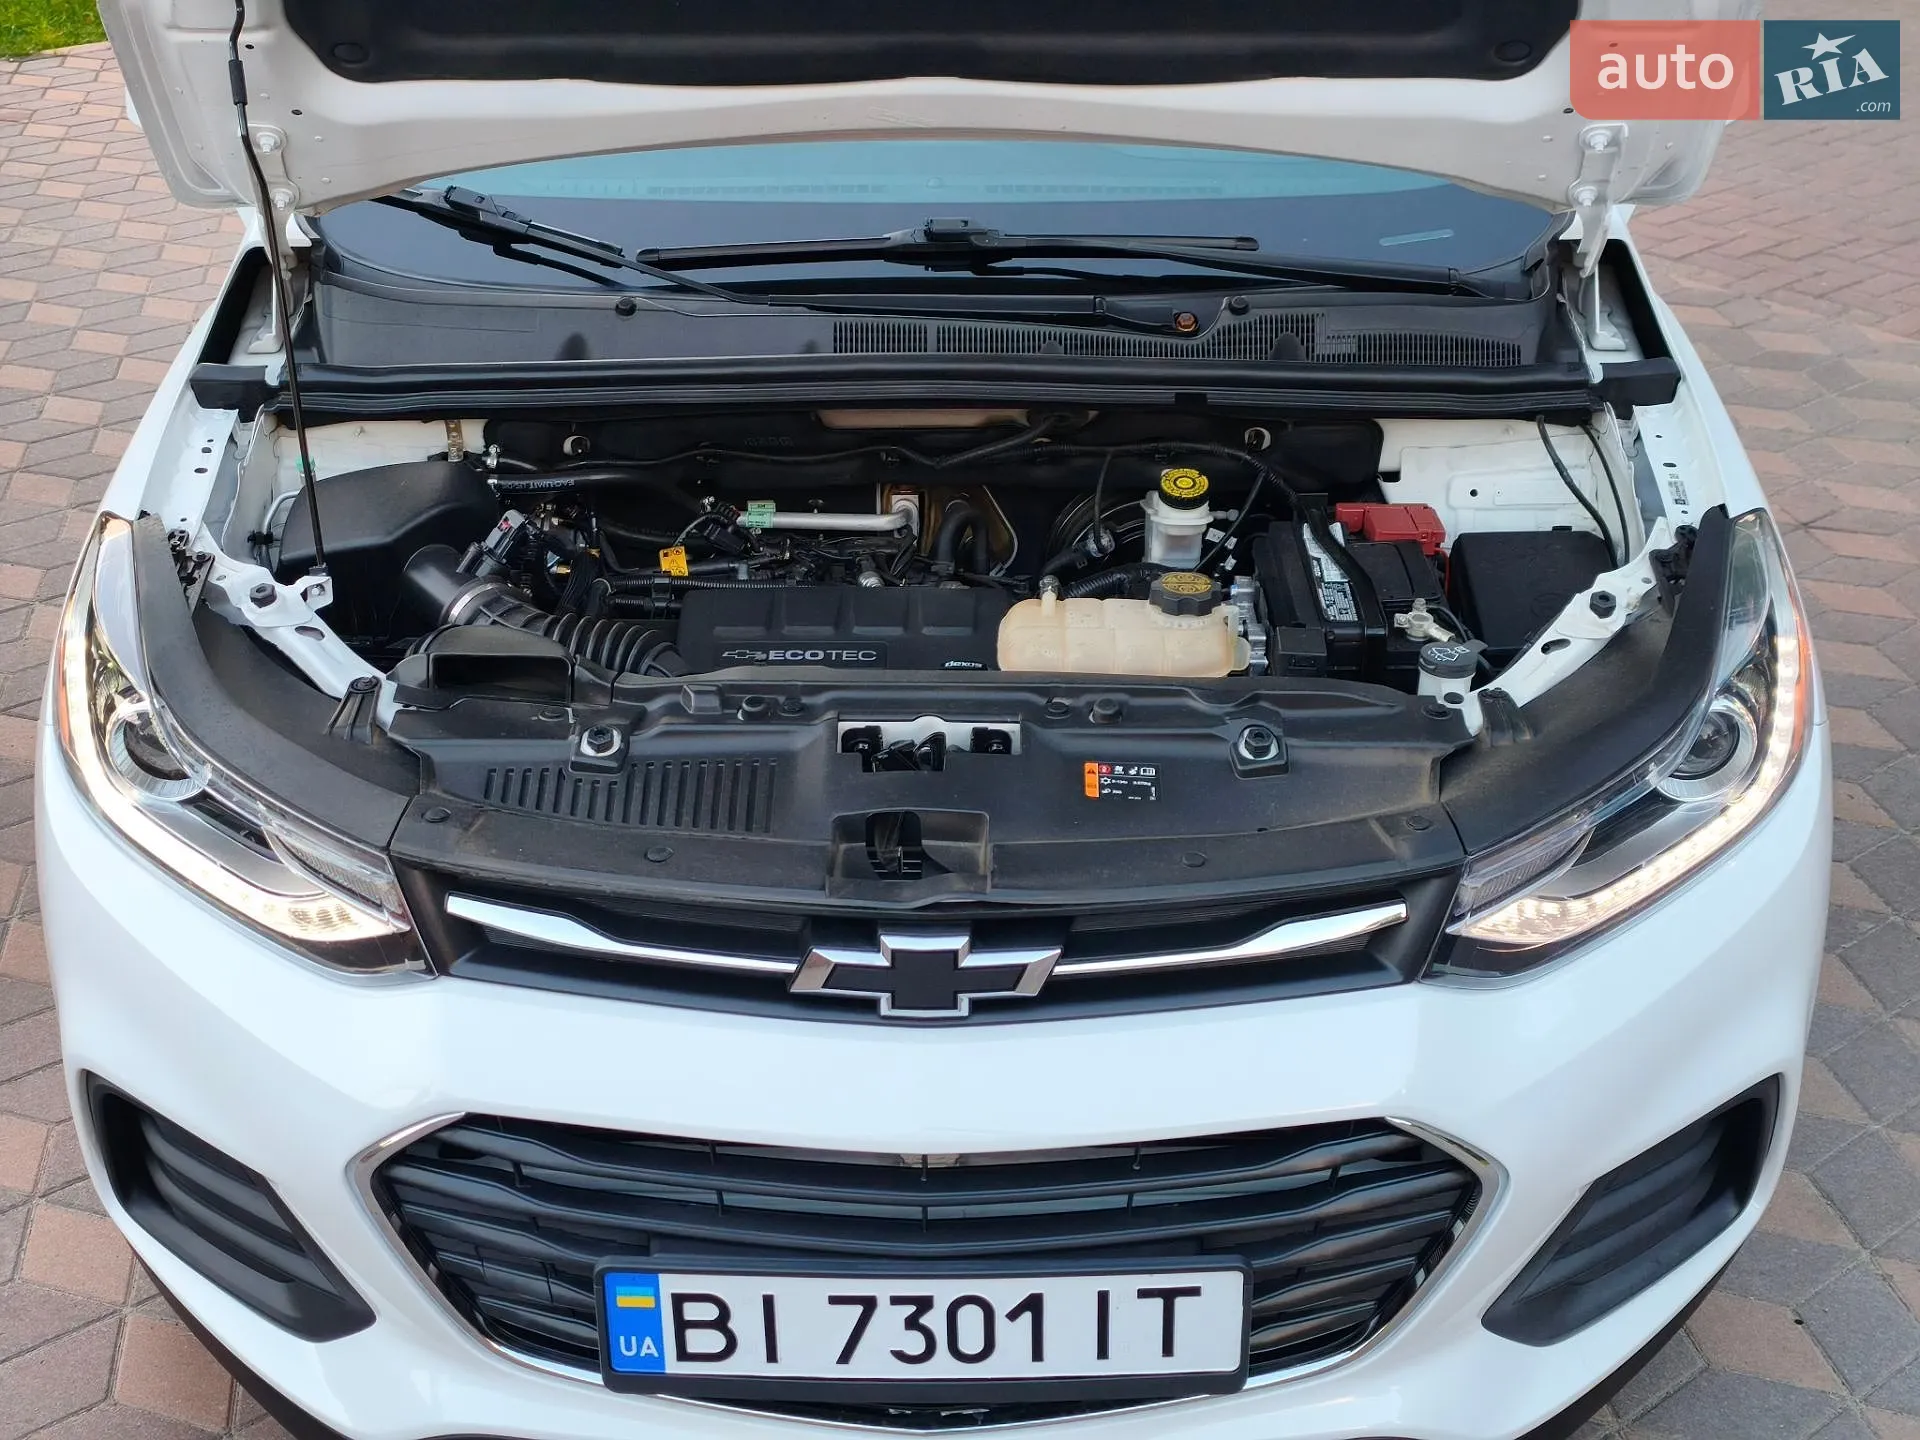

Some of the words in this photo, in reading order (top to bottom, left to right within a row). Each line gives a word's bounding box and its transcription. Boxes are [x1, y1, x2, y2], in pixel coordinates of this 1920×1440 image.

[769, 650, 877, 661] ECOTEC
[671, 1292, 779, 1364] BI
[828, 1293, 1044, 1364] 7301
[1096, 1286, 1202, 1361] IT
[620, 1336, 660, 1358] UA
